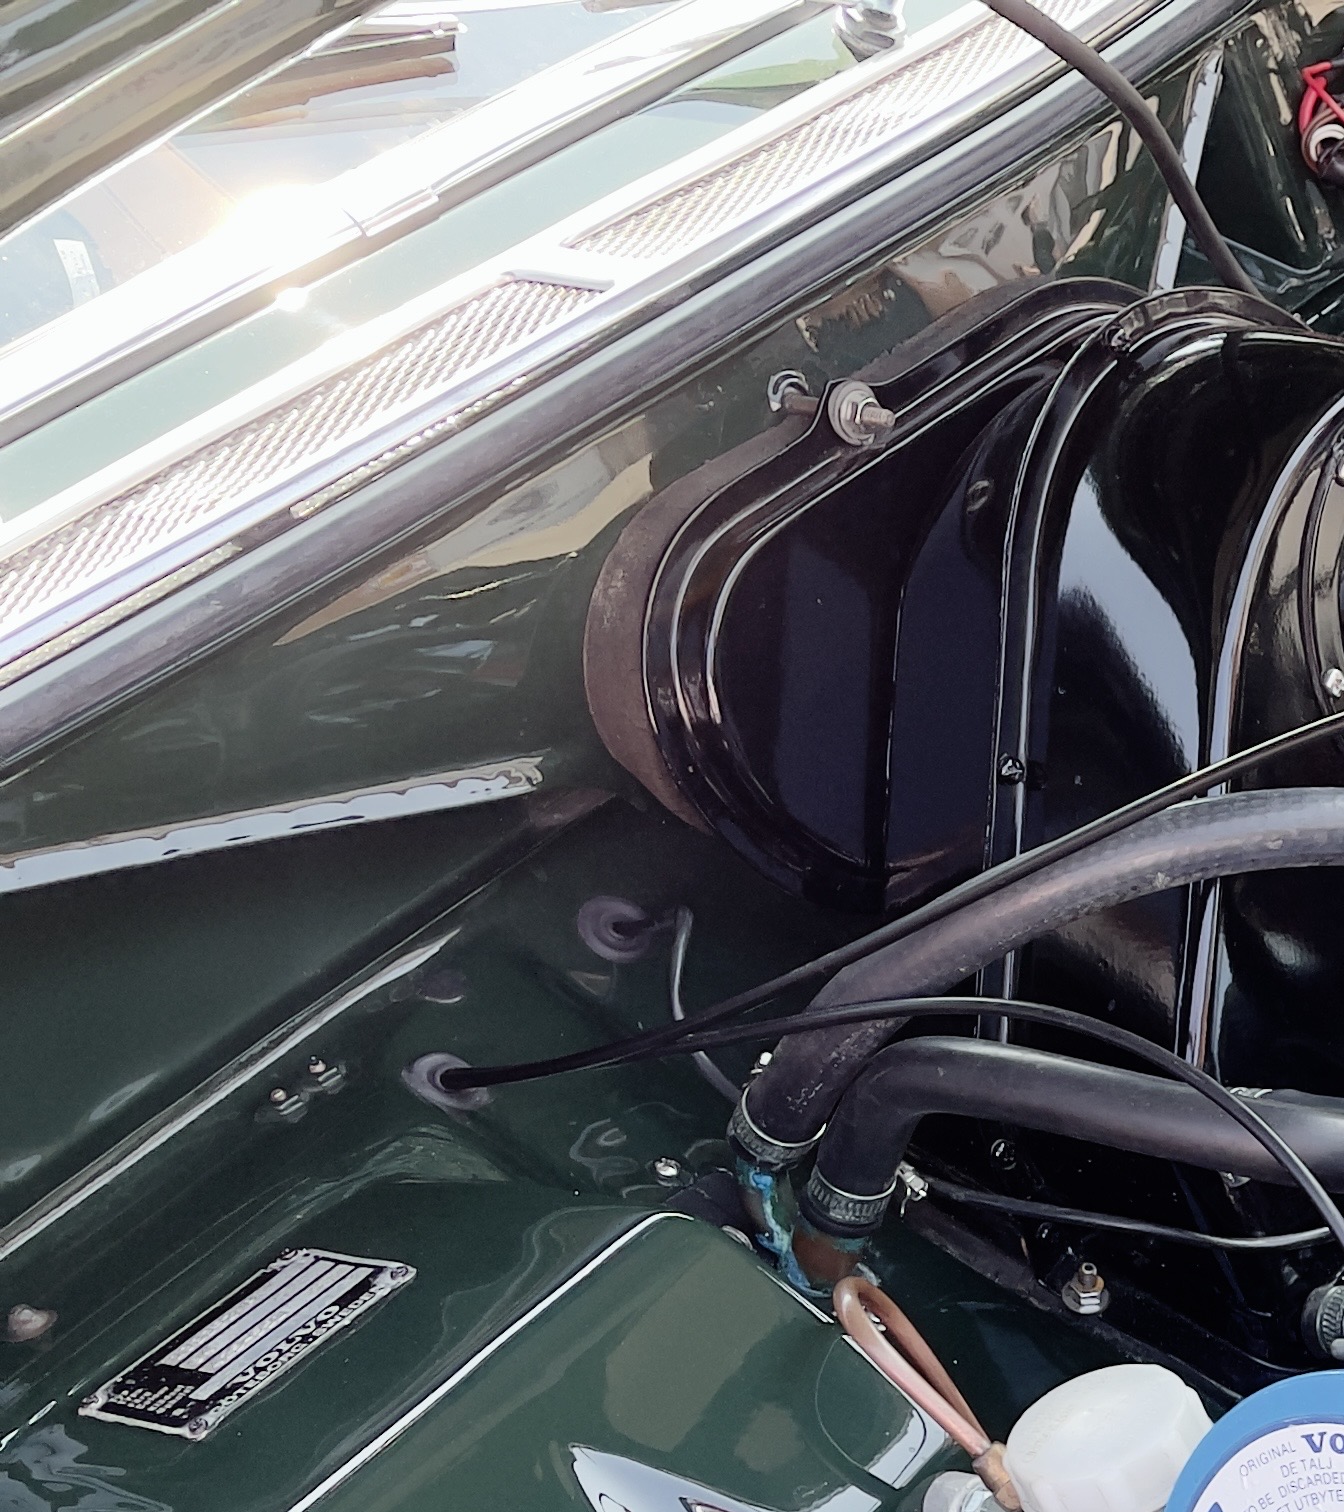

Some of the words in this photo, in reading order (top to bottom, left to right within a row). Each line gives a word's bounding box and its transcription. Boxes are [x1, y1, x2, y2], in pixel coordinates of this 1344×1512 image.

[229, 1305, 341, 1389] VOLVO
[1239, 1441, 1296, 1477] ORIGINAL
[1258, 1493, 1275, 1510] BE
